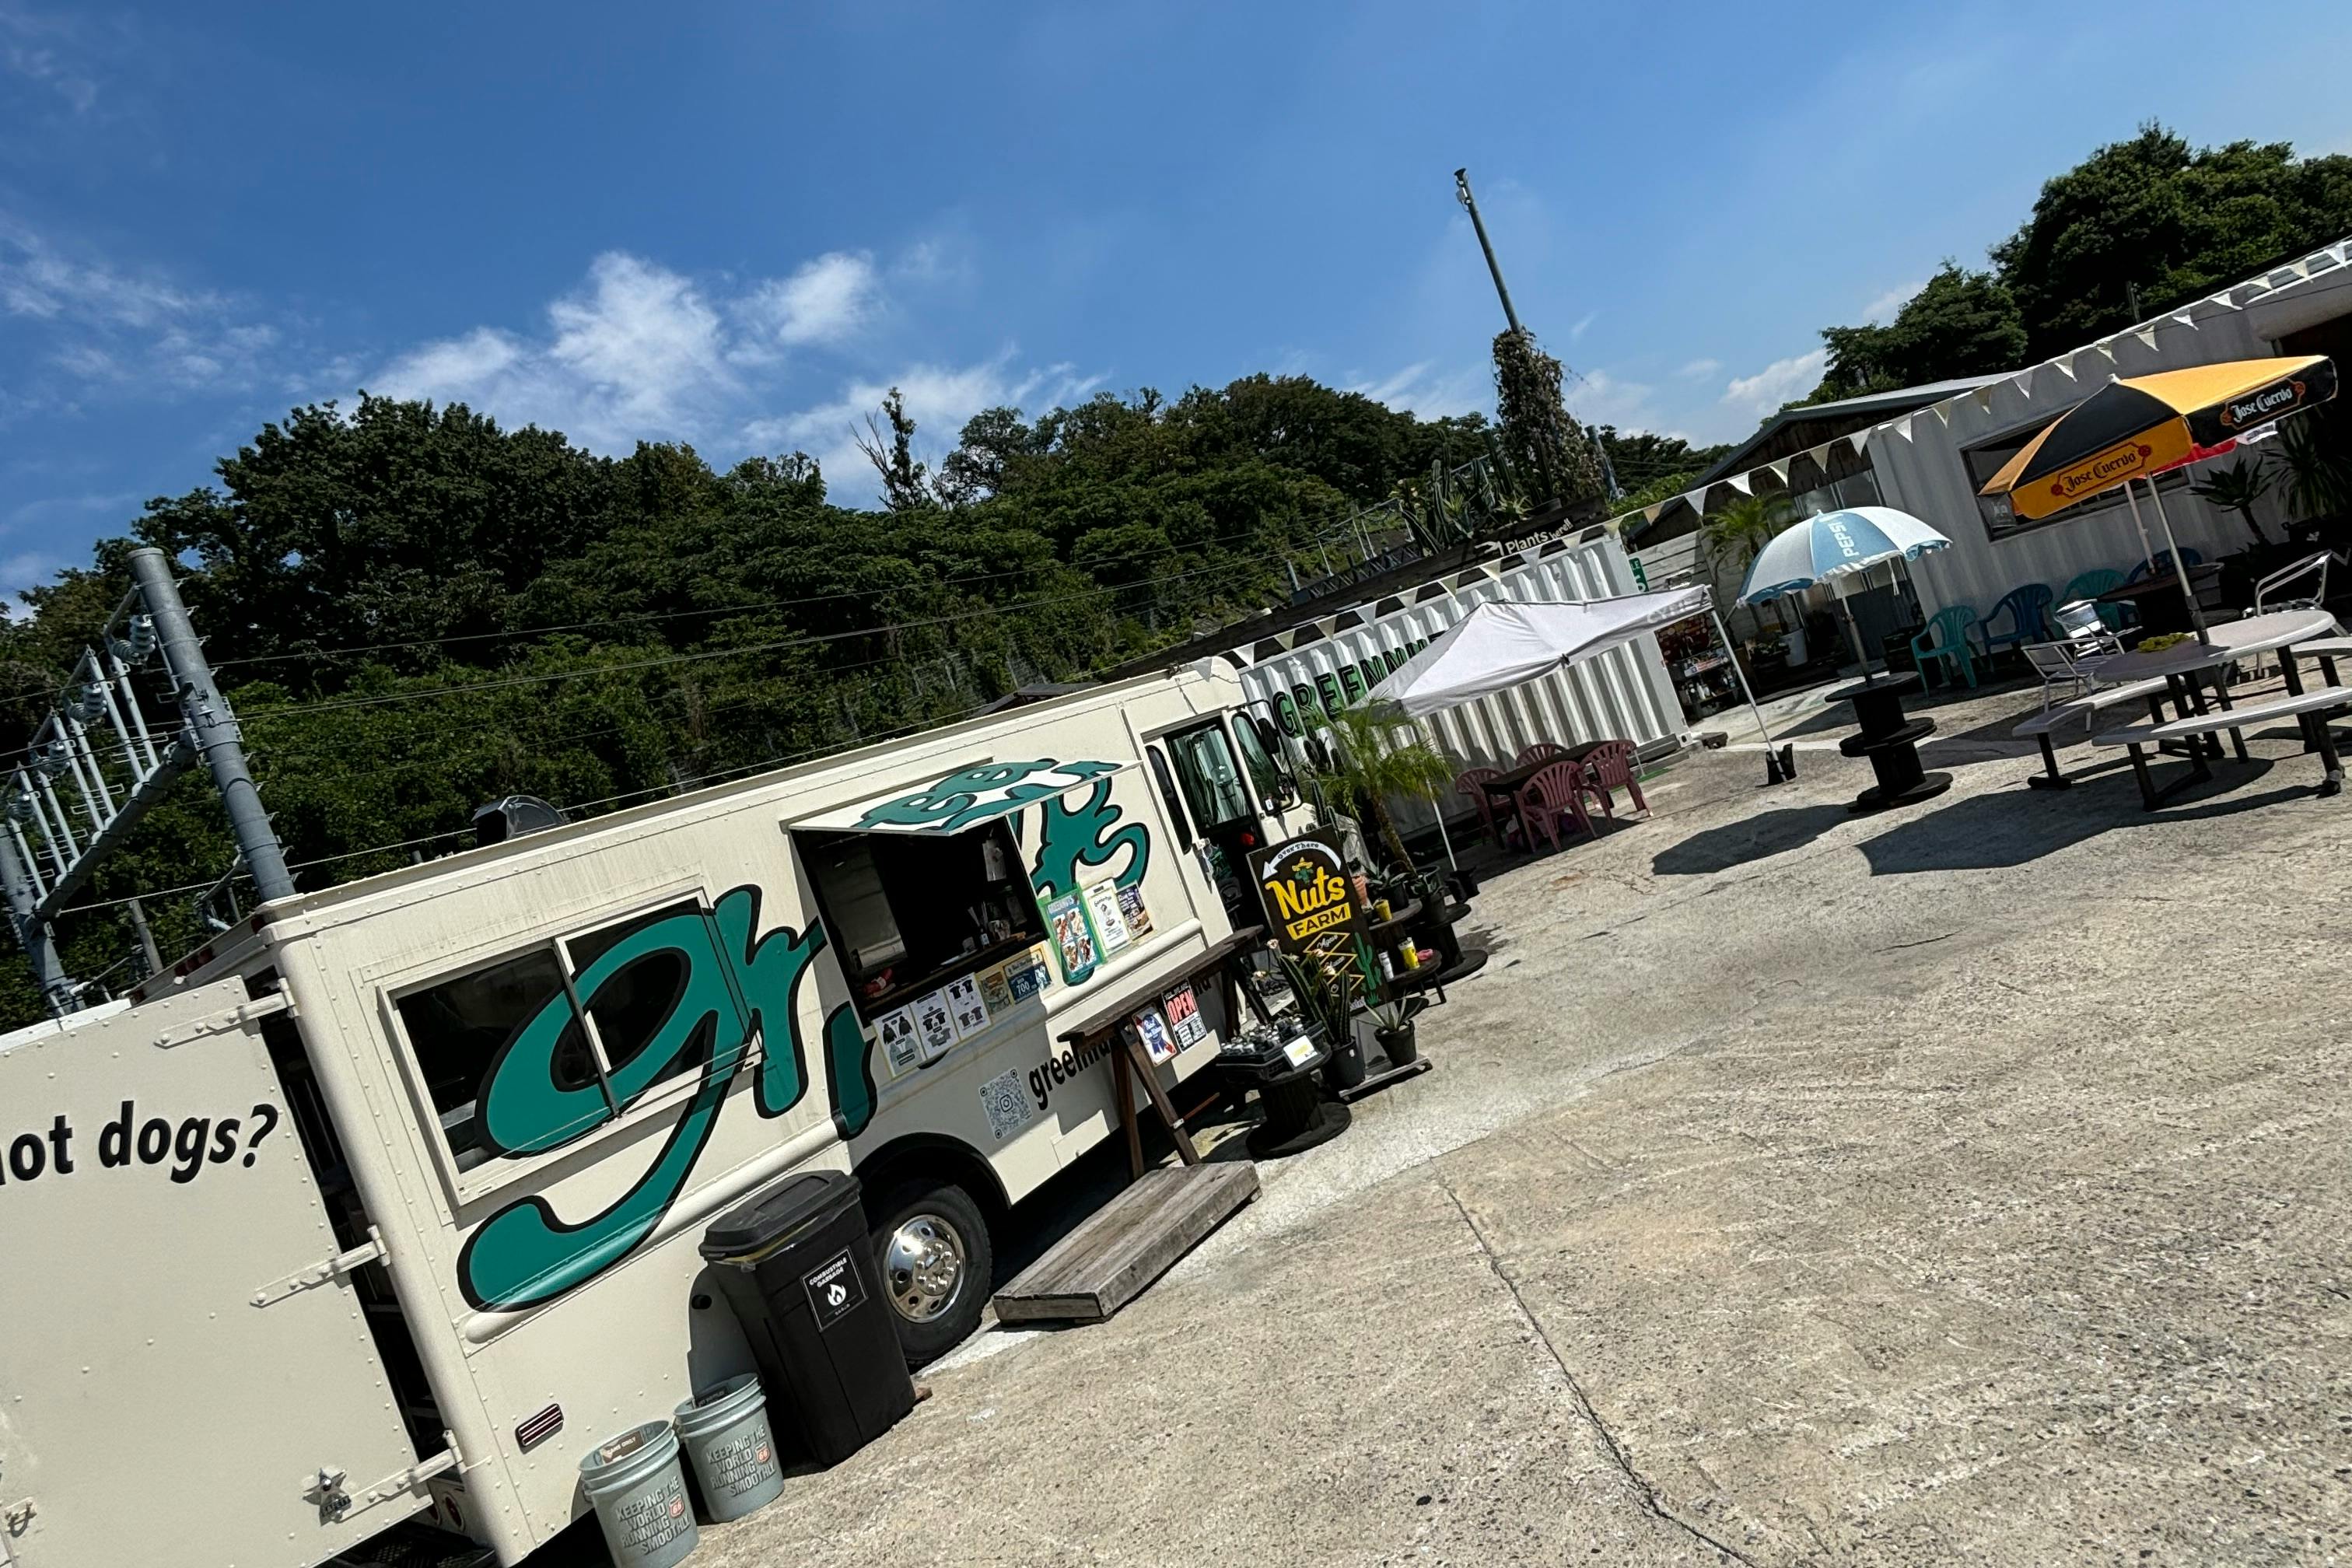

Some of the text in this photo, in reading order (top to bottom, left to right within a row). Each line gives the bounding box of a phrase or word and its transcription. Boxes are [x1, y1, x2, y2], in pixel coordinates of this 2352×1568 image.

[2230, 387, 2293, 423] Jose Cuervo
[2063, 452, 2137, 492] Jose Cuervo
[1505, 531, 1549, 554] Plants
[1827, 522, 1860, 558] PEPSI
[1265, 866, 1346, 919] Nuts
[1293, 906, 1346, 936] FARM
[1167, 989, 1197, 1024] OPEN
[0, 1100, 278, 1185] ot dogs?
[809, 1257, 848, 1286] COMBUSTIBLE
[817, 1266, 845, 1287] GARBAGE
[706, 1424, 766, 1464] KEEPING THE
[716, 1448, 753, 1474] WORLD
[758, 1447, 768, 1461] 66
[709, 1461, 757, 1489] RUNNING
[728, 1461, 776, 1496] SMOOTHLY
[616, 1475, 680, 1521] KEEPING THE
[671, 1500, 682, 1514] 66
[621, 1515, 670, 1548] RUNNING
[625, 1503, 667, 1531] WORLD
[640, 1514, 691, 1555] SMOOTHLY
